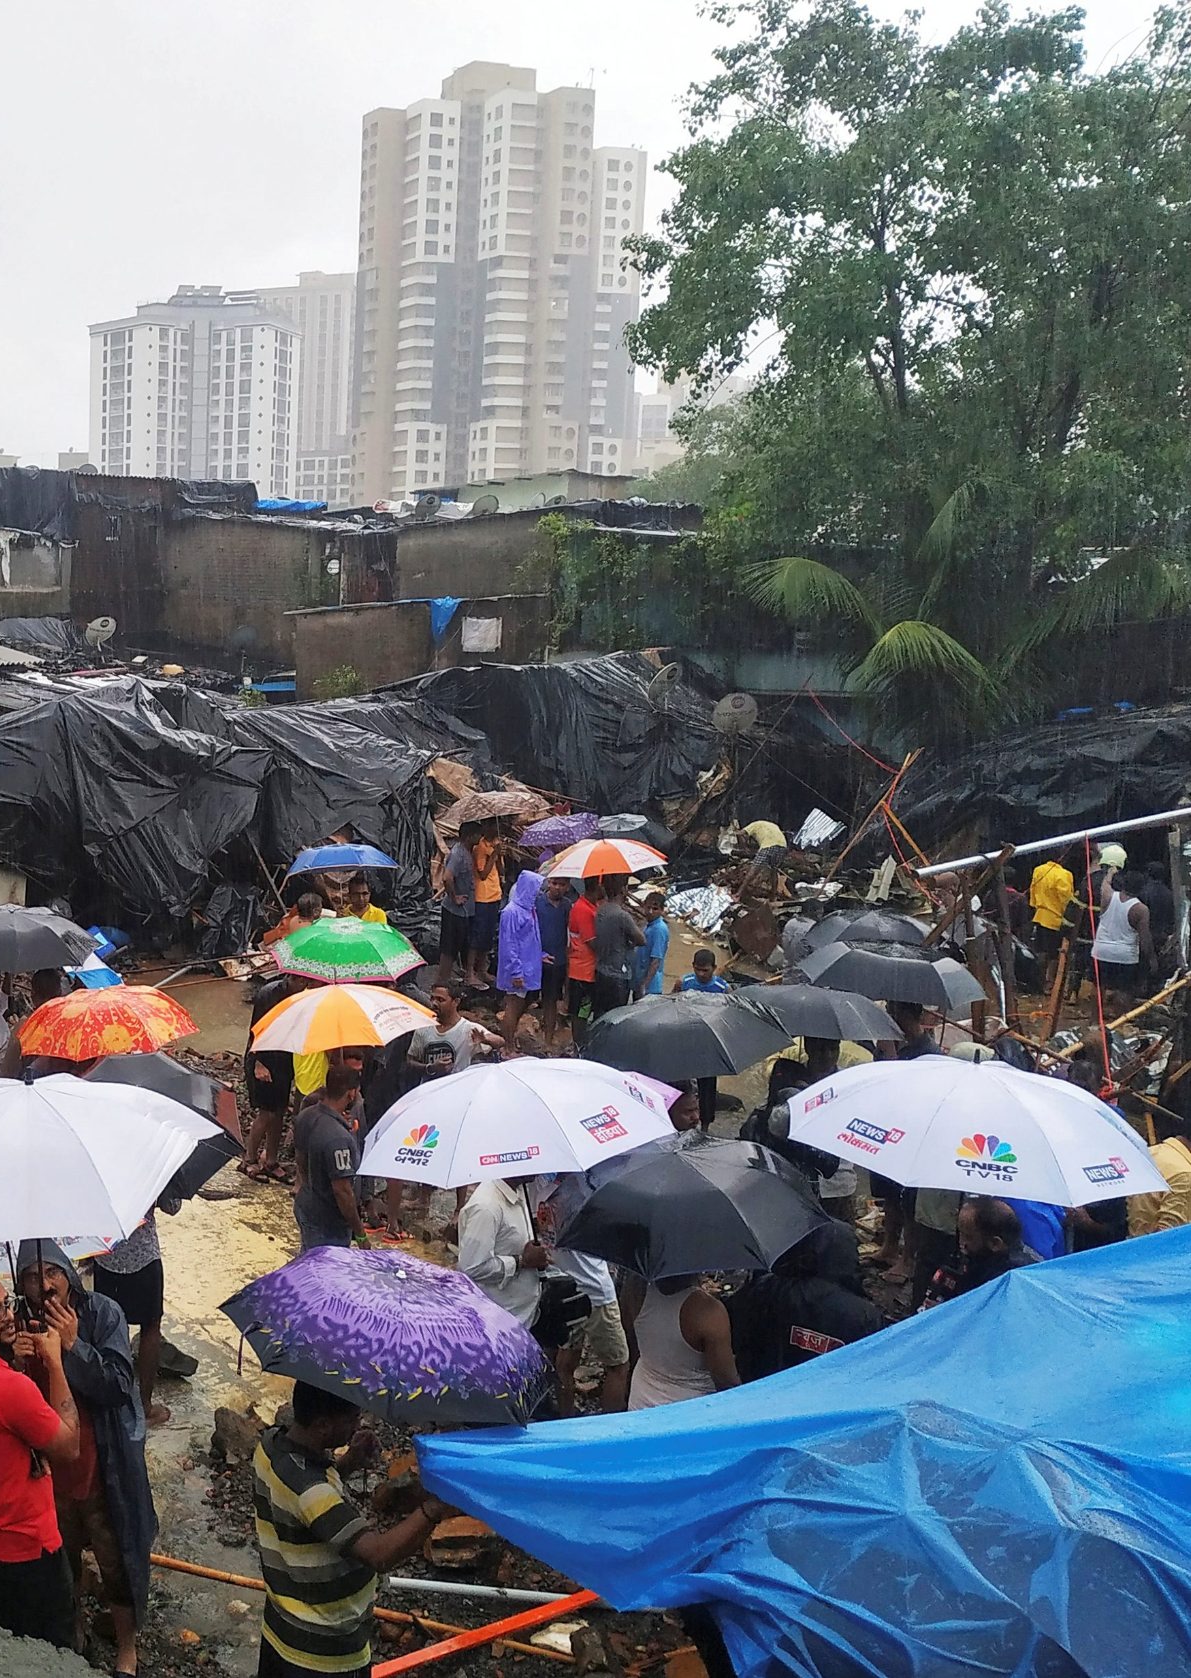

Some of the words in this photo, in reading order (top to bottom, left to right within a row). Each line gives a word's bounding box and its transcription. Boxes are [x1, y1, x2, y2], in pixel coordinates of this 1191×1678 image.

[581, 1113, 610, 1129] NEWS
[849, 1119, 886, 1141] NEWS
[887, 1130, 903, 1142] 18
[837, 1132, 880, 1155] लोकमत
[334, 1149, 352, 1170] 07
[397, 1147, 434, 1158] CNBC
[499, 1152, 528, 1162] NEWS
[955, 1159, 1019, 1174] CNBC
[1084, 1166, 1119, 1181] NEWS
[961, 1168, 1014, 1182] TV18
